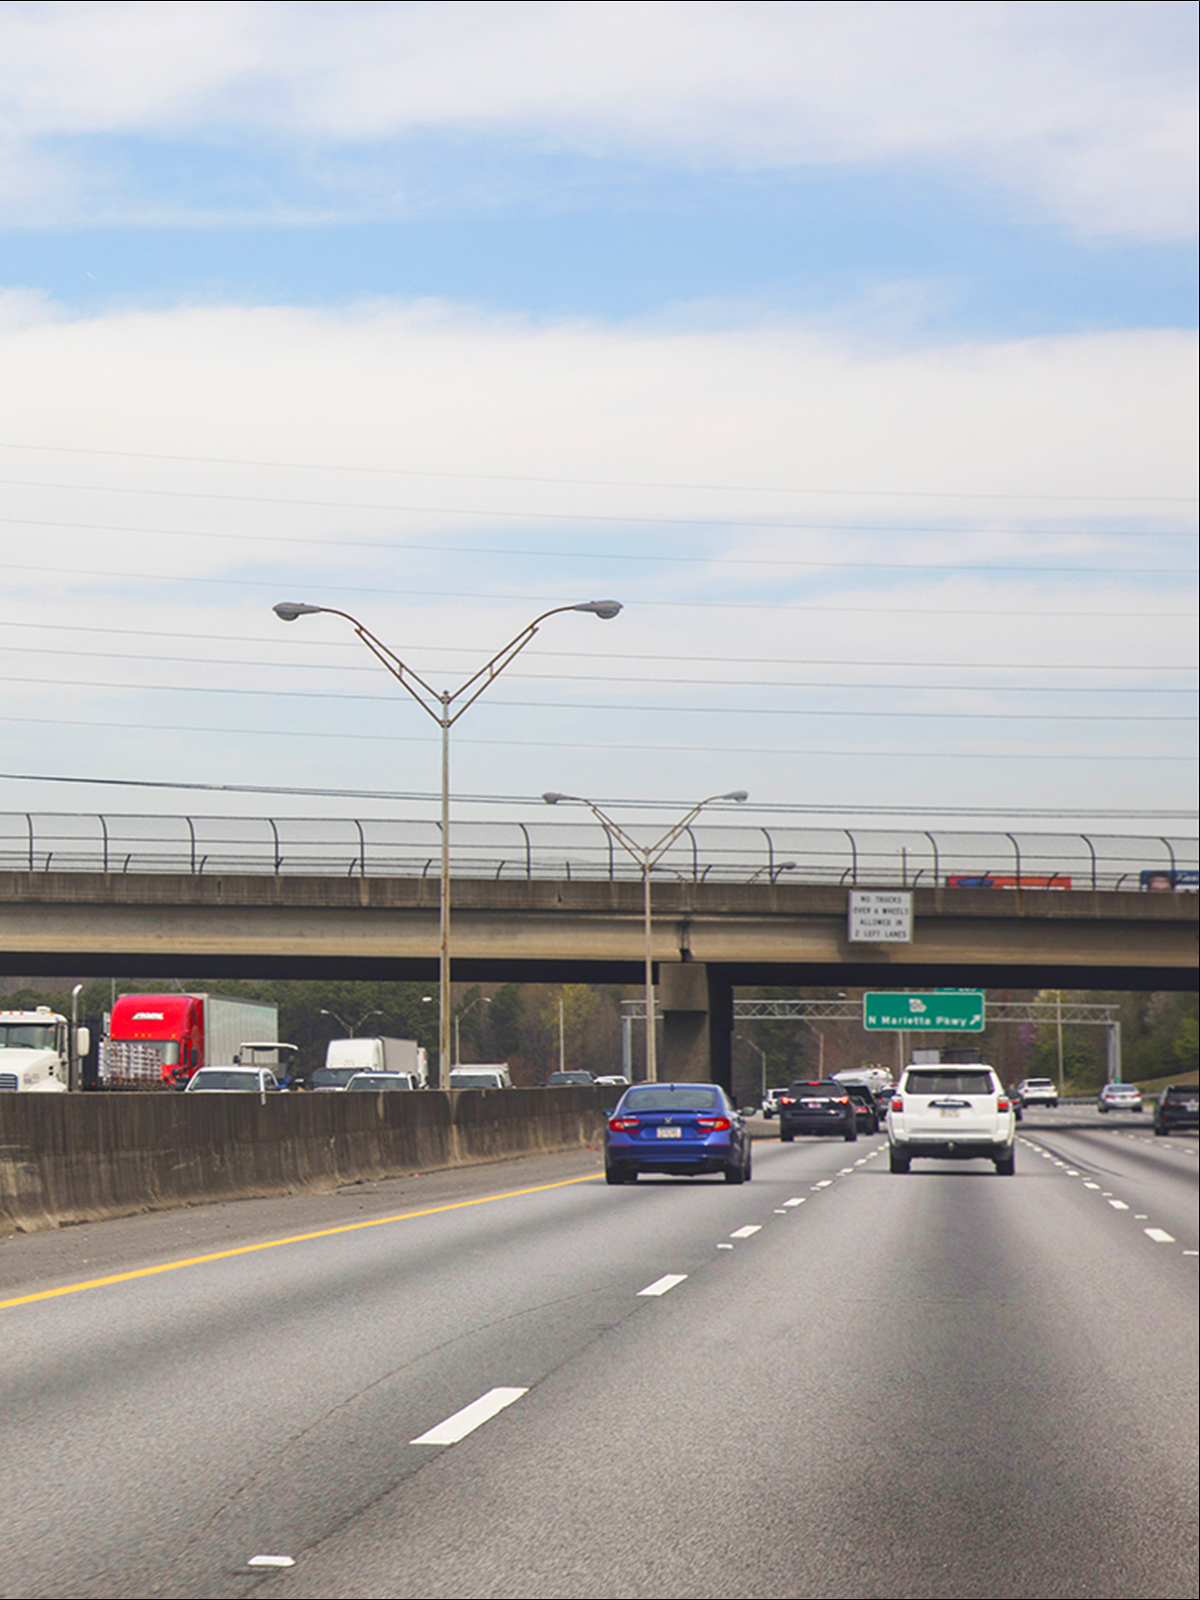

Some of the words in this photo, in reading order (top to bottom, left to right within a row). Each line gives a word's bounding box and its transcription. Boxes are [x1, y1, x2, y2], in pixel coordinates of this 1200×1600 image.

[853, 906, 871, 914] OVER
[854, 929, 860, 937] 2
[864, 930, 880, 938] LEFT
[885, 930, 907, 938] LANES
[868, 1015, 876, 1025] N
[881, 1015, 931, 1026] Marietta
[936, 1016, 967, 1027] Pkwy
